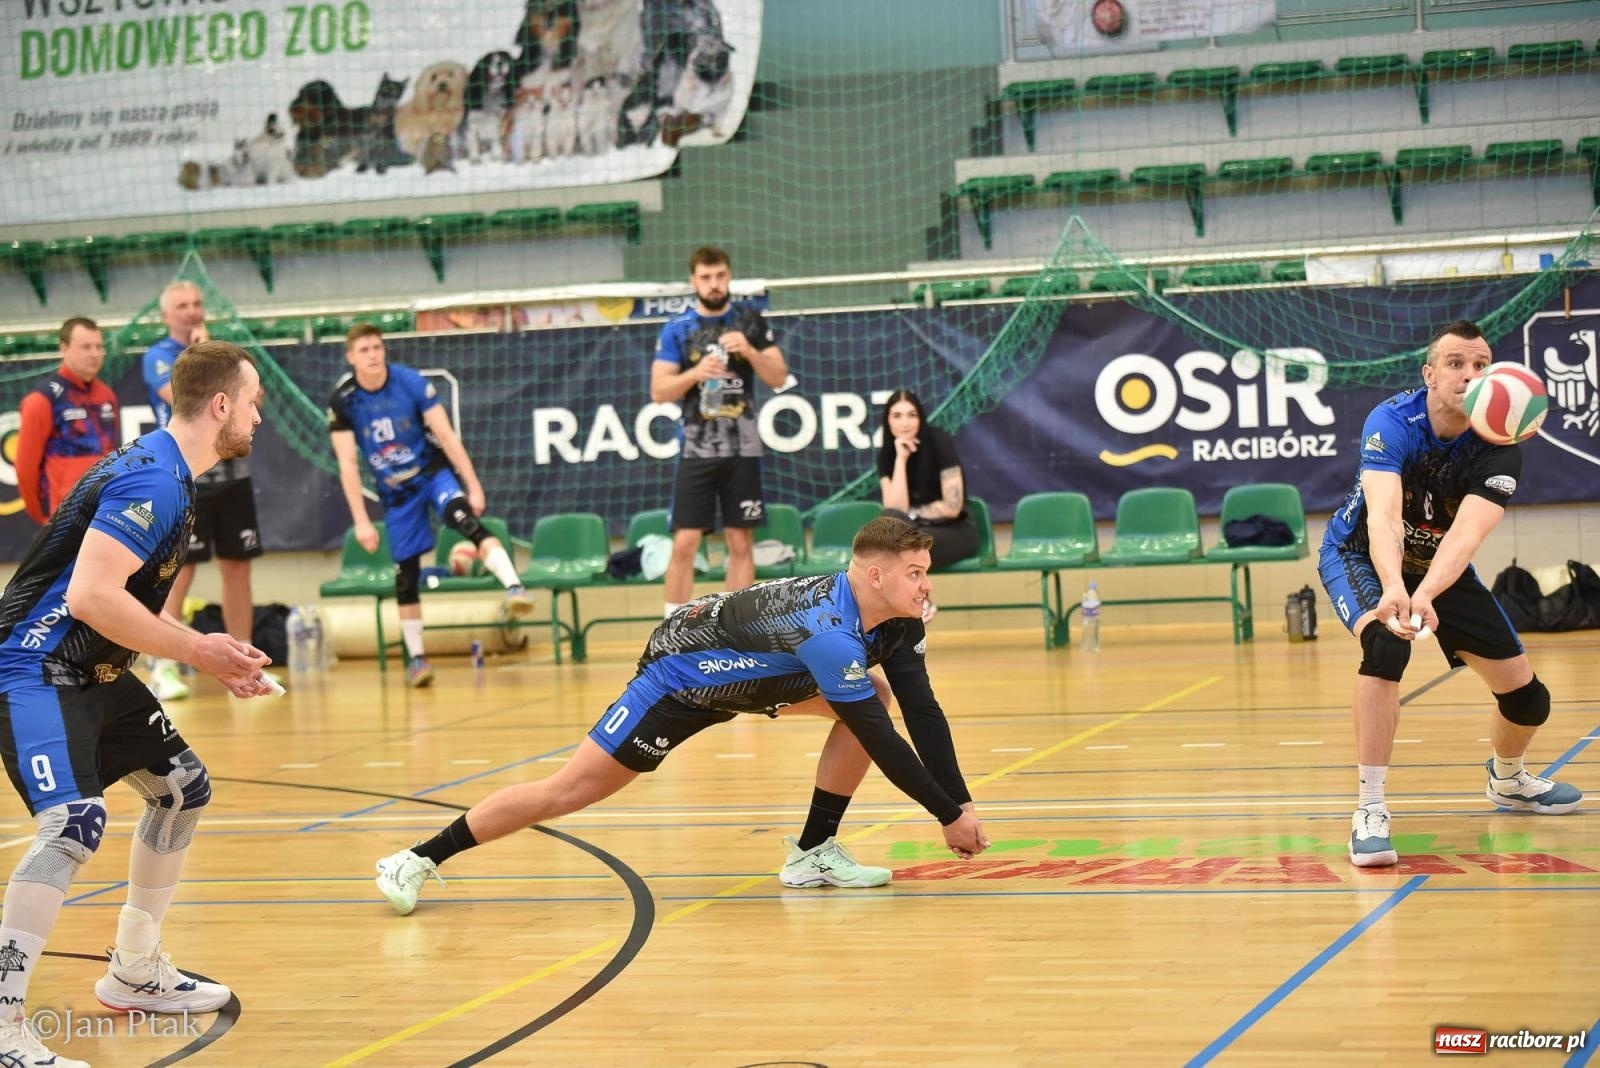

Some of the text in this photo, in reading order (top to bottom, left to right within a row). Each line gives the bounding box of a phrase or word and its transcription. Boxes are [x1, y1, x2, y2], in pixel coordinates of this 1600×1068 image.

[20, 0, 371, 81] DOMOWEGO ZOO
[12, 110, 83, 132] Dzielimy
[370, 416, 396, 444] 20
[532, 374, 895, 464] RACÓR
[1192, 429, 1337, 462] RACIBÓRZ
[128, 502, 156, 525] LASEL
[604, 705, 630, 735] 0
[31, 755, 57, 792] 9
